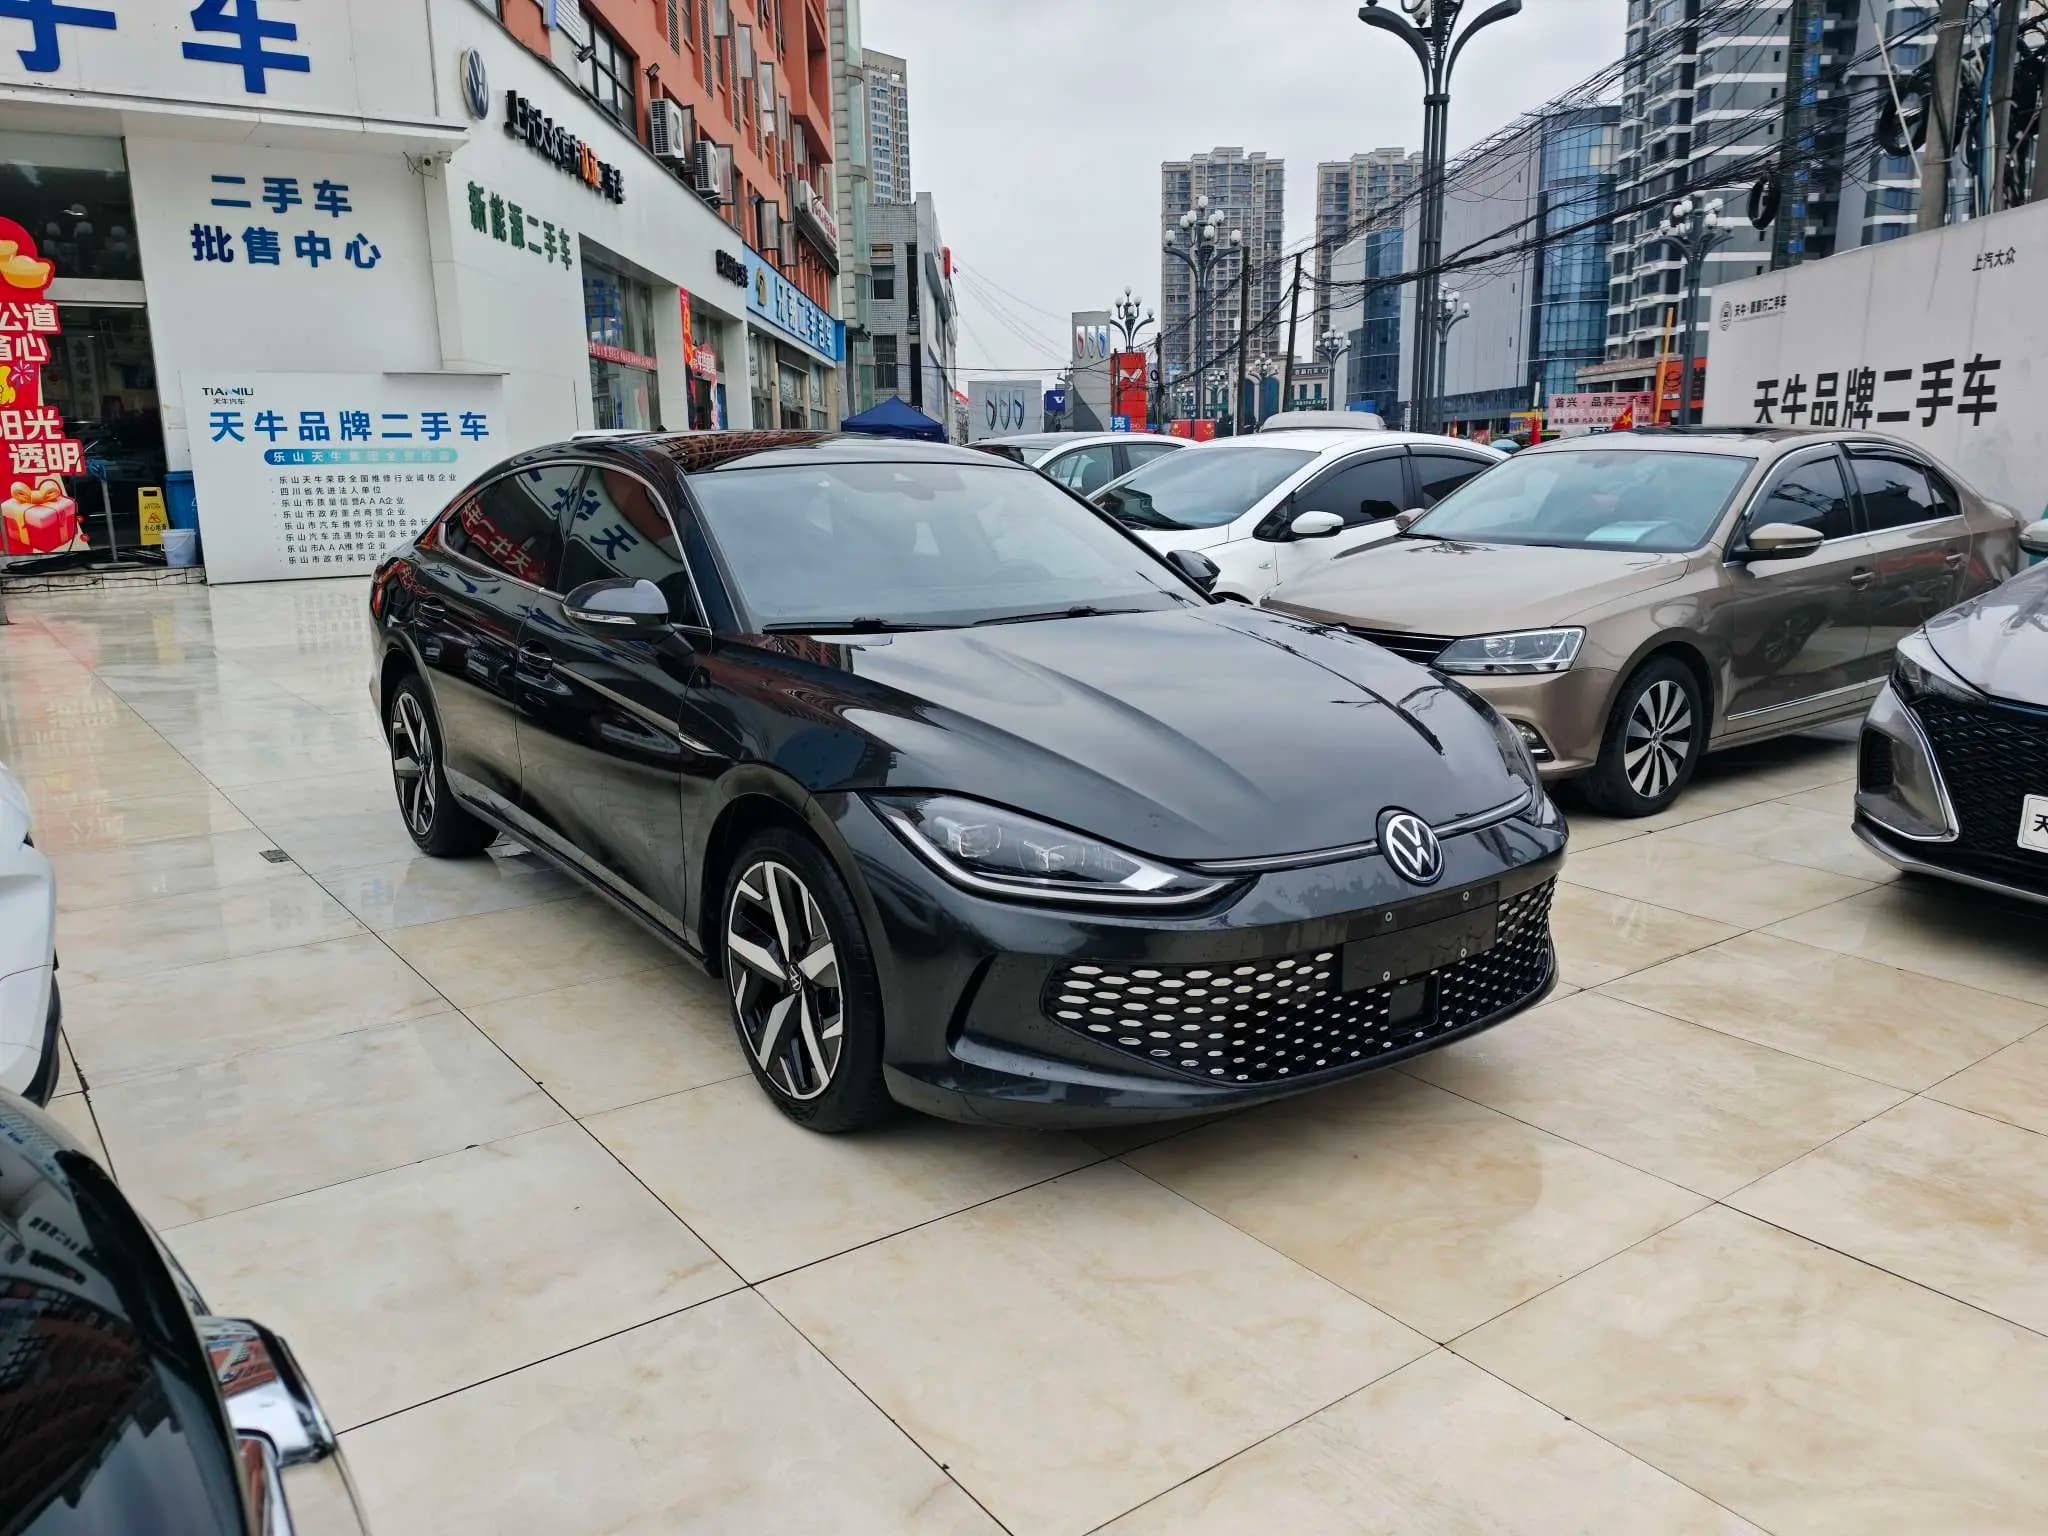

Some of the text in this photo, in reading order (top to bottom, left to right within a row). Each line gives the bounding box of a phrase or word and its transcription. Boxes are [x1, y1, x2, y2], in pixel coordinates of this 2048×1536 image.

[210, 174, 353, 218] 二手车
[190, 223, 382, 270] 批售中心
[467, 180, 574, 272] 新能源二手车
[1971, 246, 2017, 272] 上汽大众
[1752, 352, 2002, 430] 天牛品牌二手车
[209, 409, 490, 443] 天牛品牌二手车
[9, 442, 83, 475] 透明
